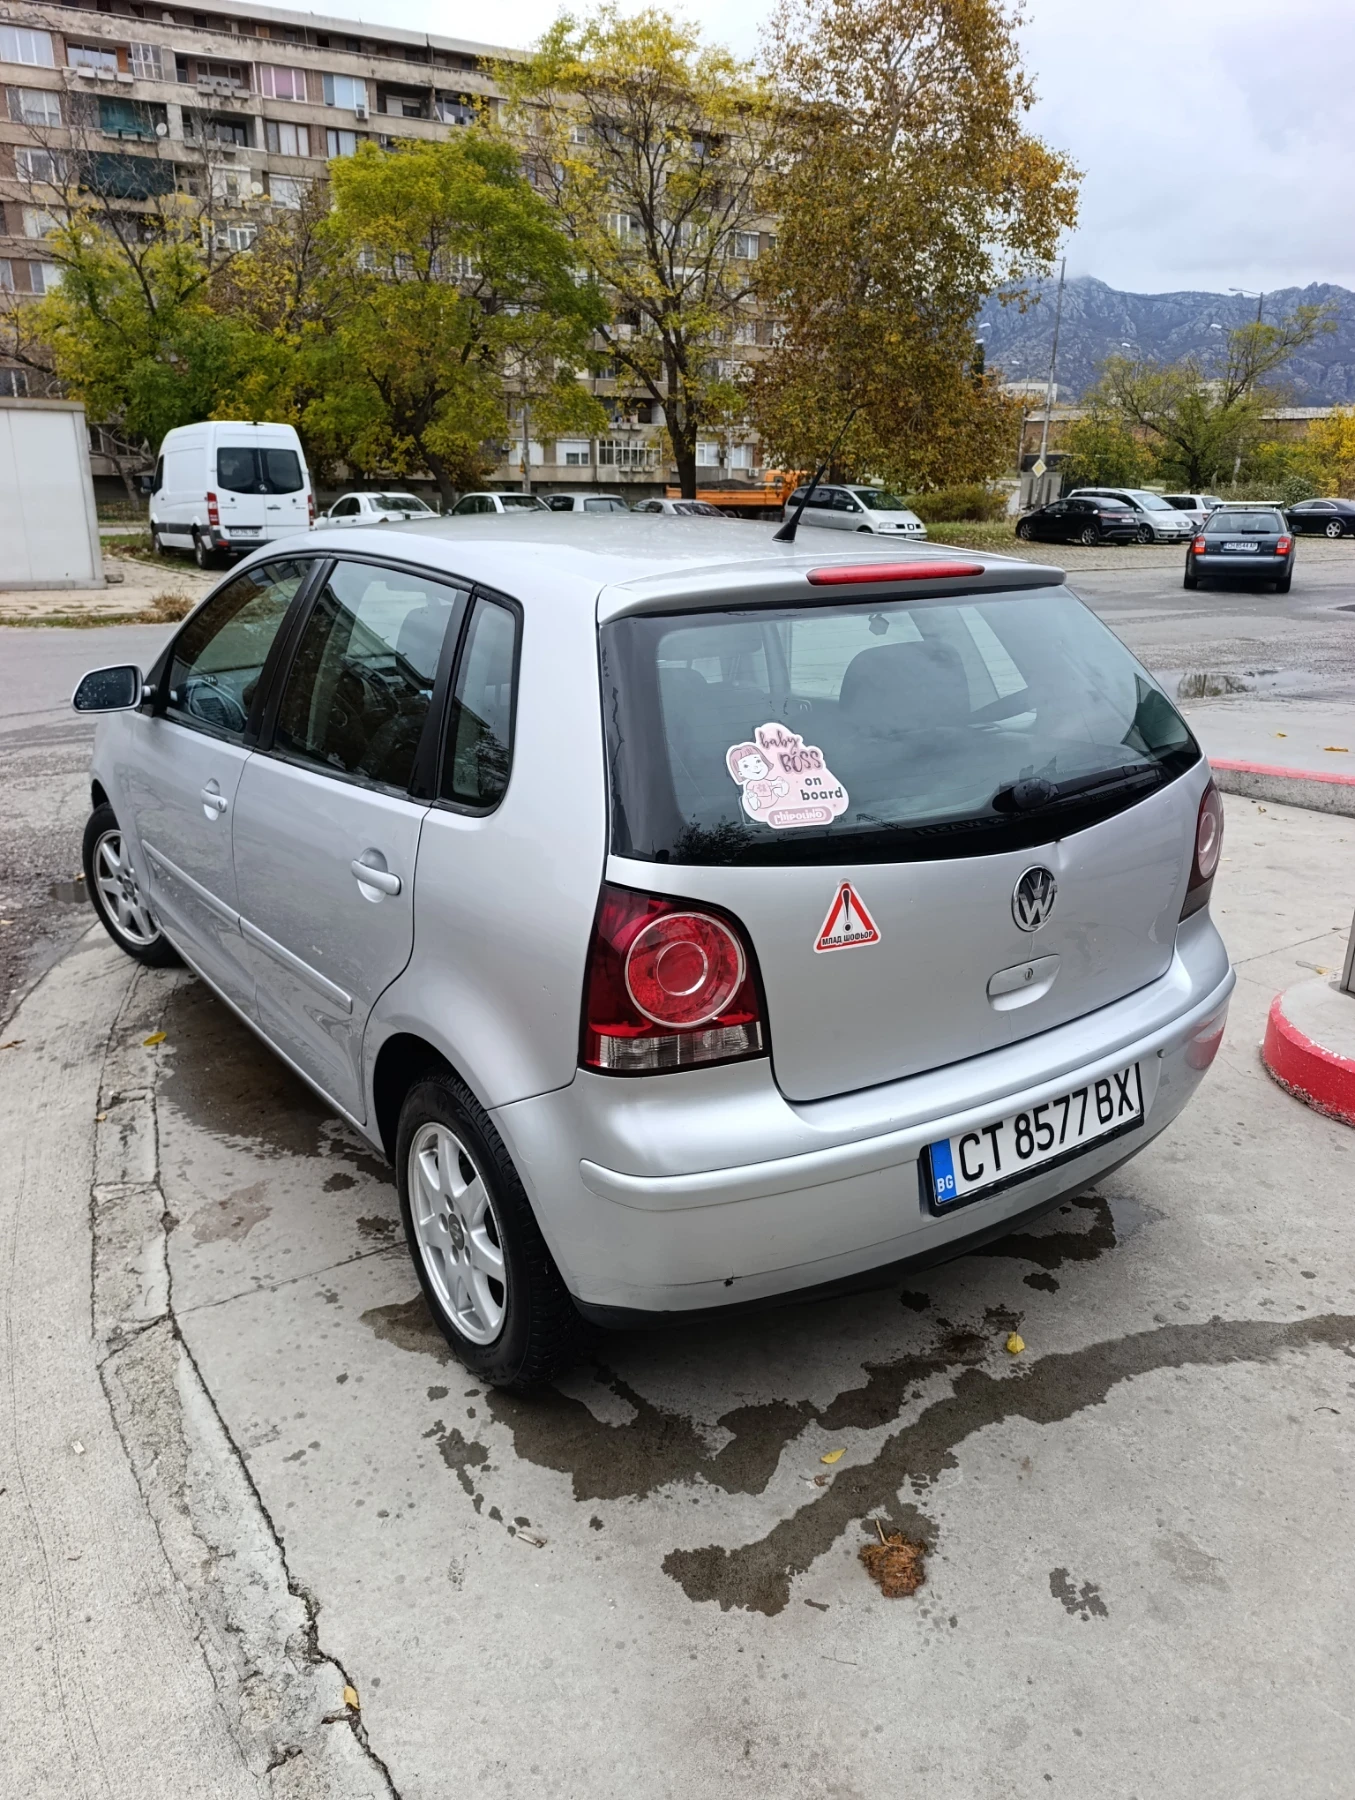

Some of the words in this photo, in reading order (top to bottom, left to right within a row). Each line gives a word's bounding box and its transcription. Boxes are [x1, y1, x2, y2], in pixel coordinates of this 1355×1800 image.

[759, 729, 800, 755] baby
[780, 750, 822, 773] BOSS
[804, 777, 822, 786] on
[800, 786, 844, 801] board
[822, 935, 842, 946] МЛАД
[843, 930, 873, 942] ШОФЬОР
[958, 1120, 1004, 1182] CT
[1014, 1086, 1089, 1160] 8577
[1094, 1068, 1135, 1125] BX
[936, 1174, 954, 1193] BG
